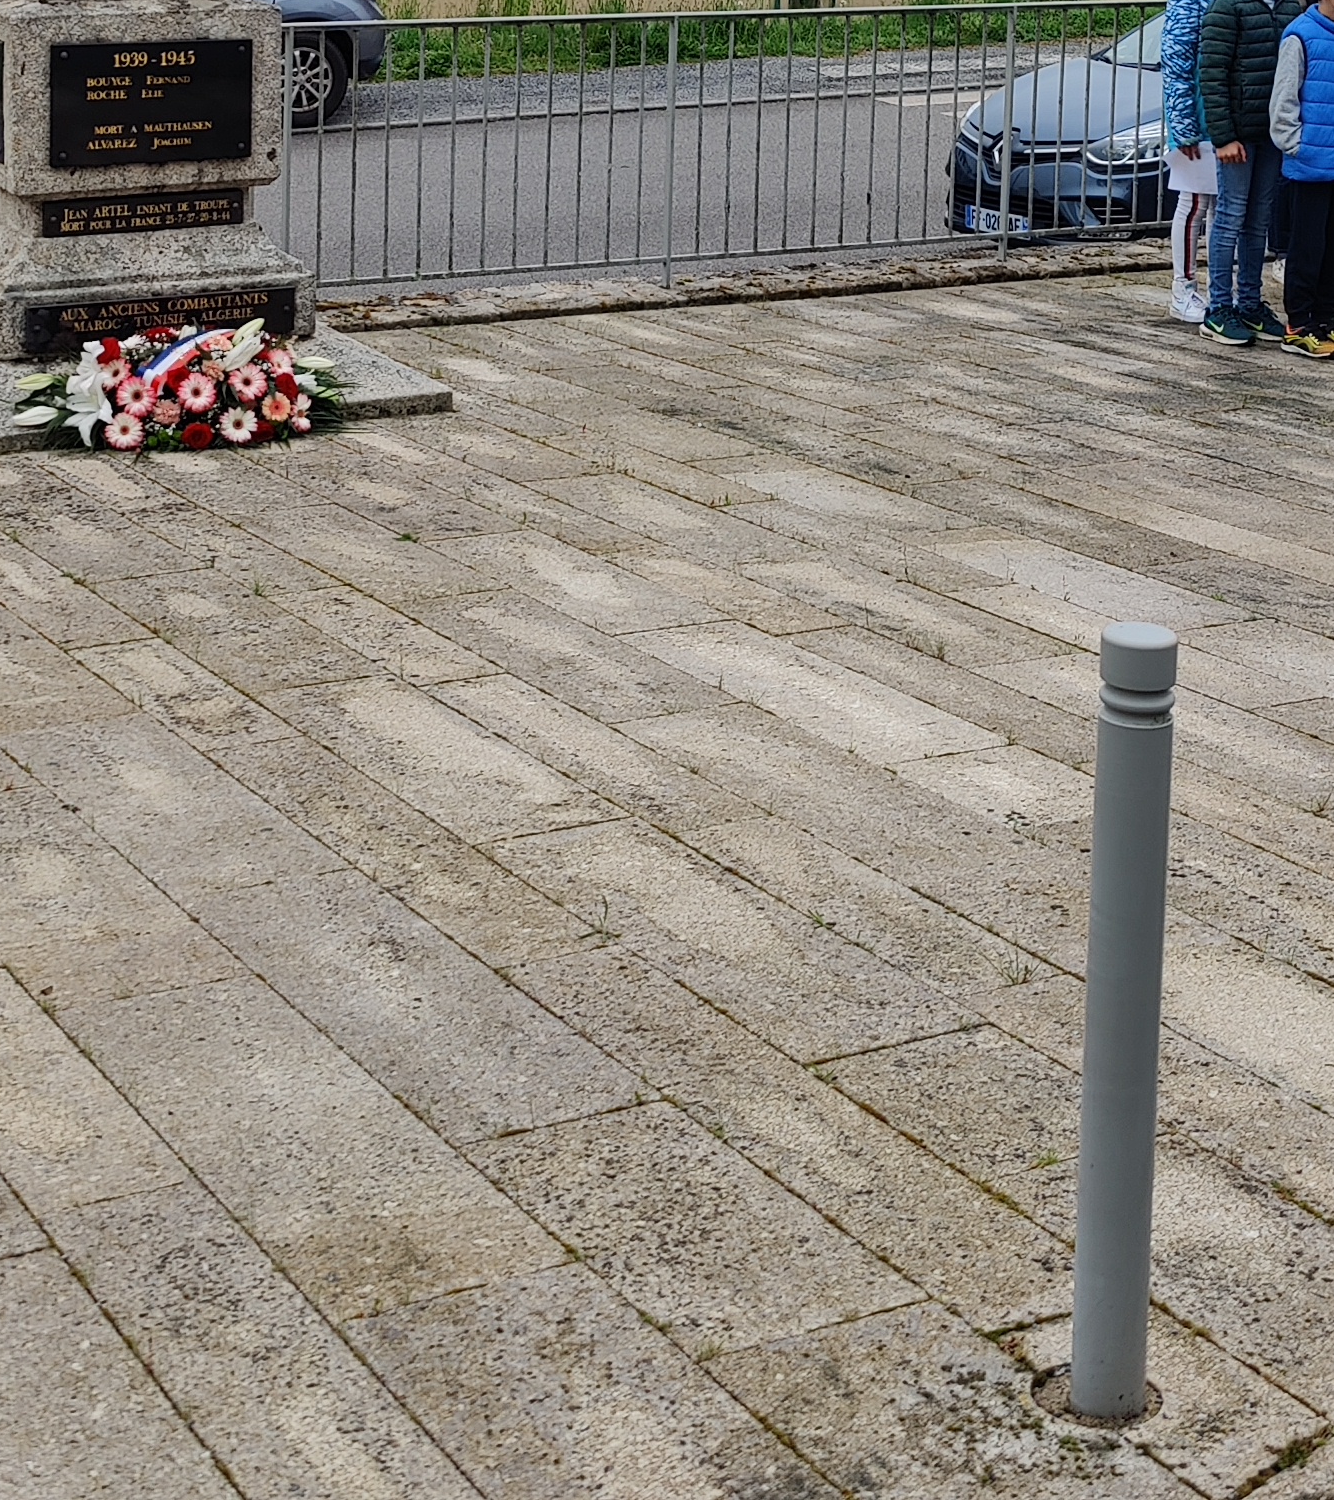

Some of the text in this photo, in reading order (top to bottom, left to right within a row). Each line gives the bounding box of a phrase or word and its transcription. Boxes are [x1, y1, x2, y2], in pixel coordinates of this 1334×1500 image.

[113, 51, 148, 68] 1939
[160, 50, 196, 67] 1945
[86, 90, 128, 101] ROCHE
[94, 124, 124, 135] MORT
[143, 121, 213, 133] MAUTHAUSEN
[86, 138, 138, 150] ALVAREZ
[63, 199, 230, 223] JEAN ARTEL ENFANT DE TROUPE
[60, 221, 86, 233] MORT
[89, 220, 112, 231] POUR
[115, 219, 127, 228] LA
[131, 216, 162, 228] FRANCE
[59, 292, 269, 321] AUX ANCIENS COMBATTANTS
[133, 312, 187, 328] TUNISIE
[200, 307, 255, 322] ALGERIE
